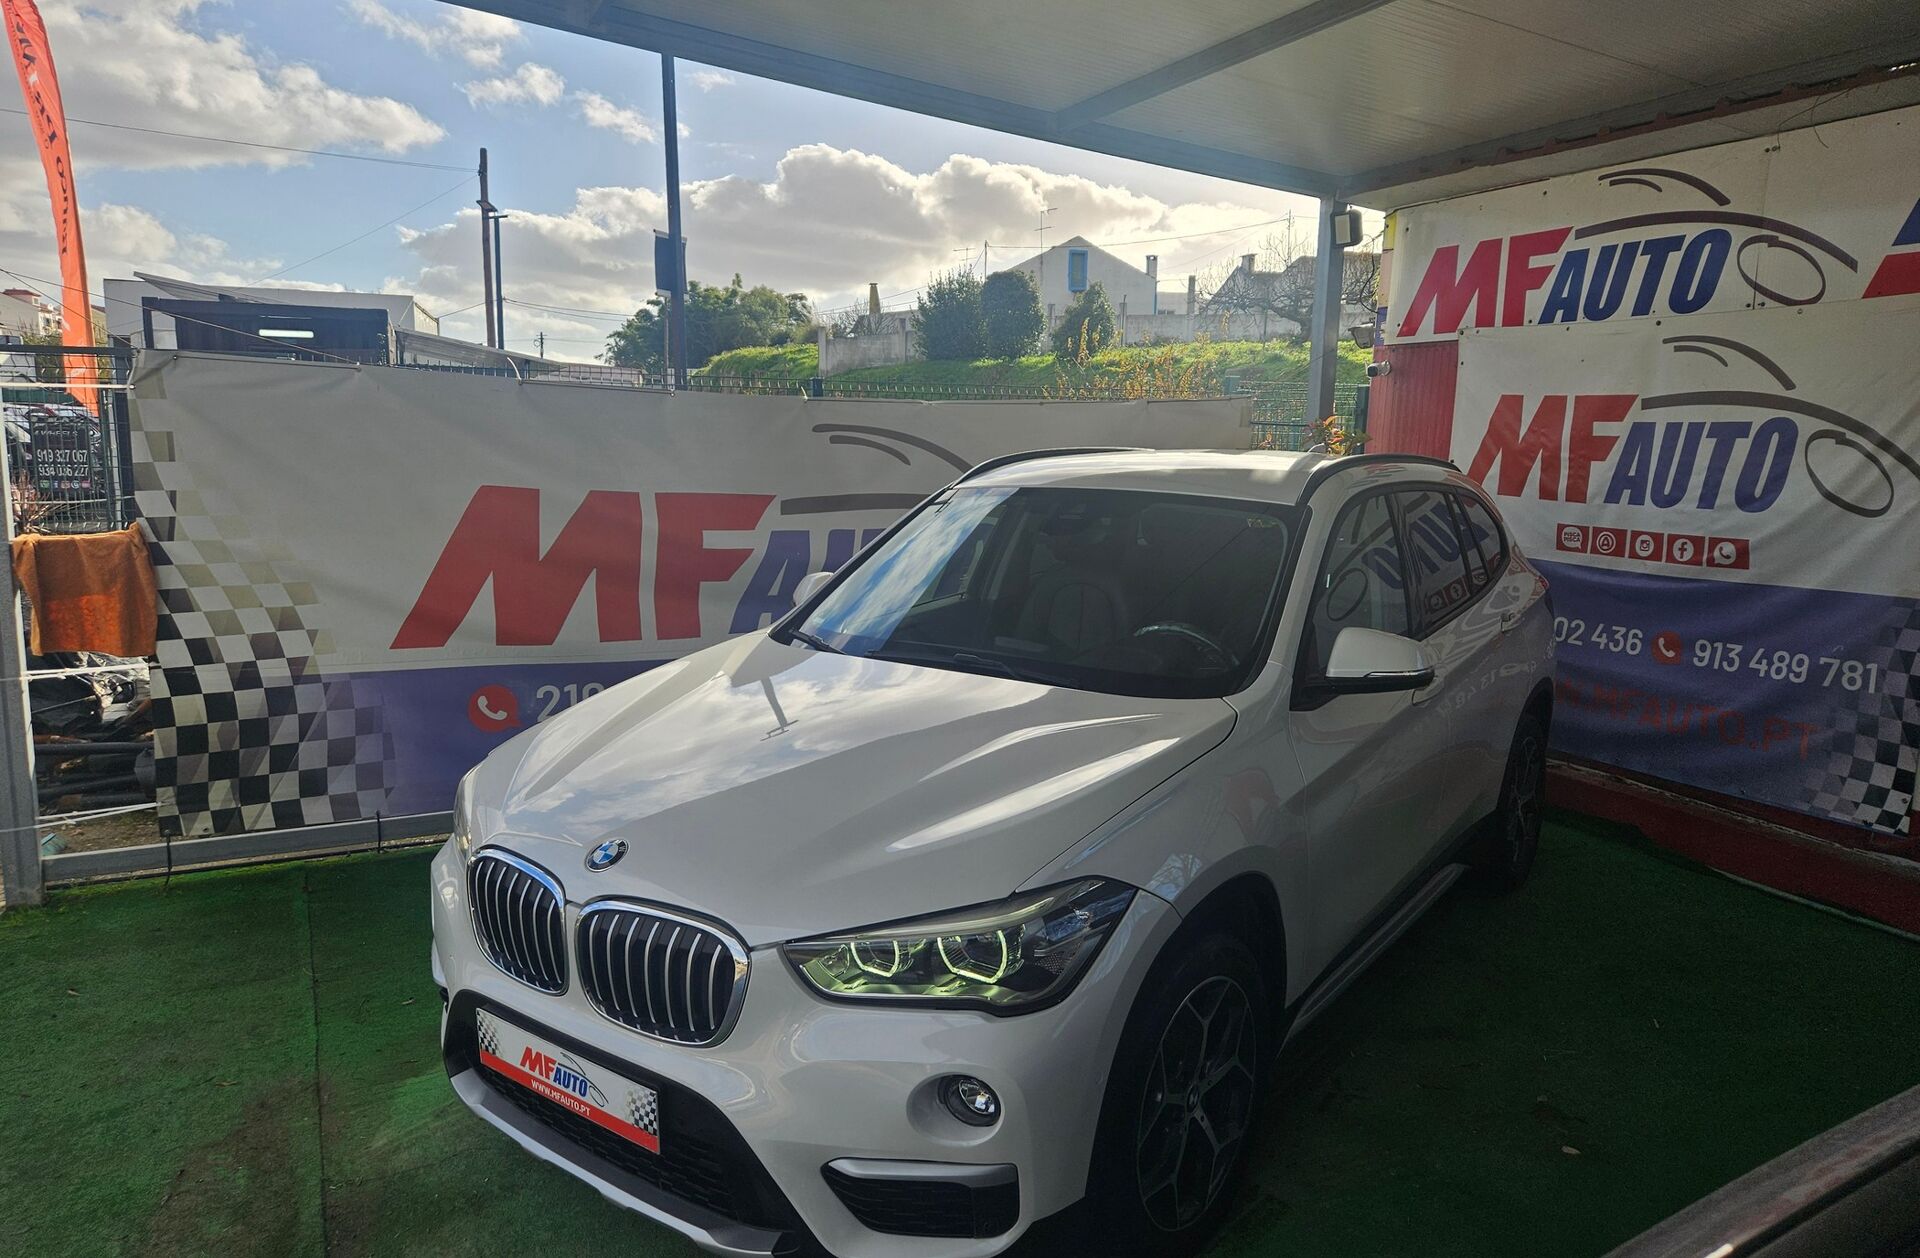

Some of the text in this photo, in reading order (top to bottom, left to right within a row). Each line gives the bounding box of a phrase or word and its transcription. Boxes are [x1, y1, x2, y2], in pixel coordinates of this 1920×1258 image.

[1590, 623, 1643, 656] 436
[1692, 639, 1742, 673] 913
[1748, 646, 1810, 684] 489
[1819, 657, 1878, 694] 781
